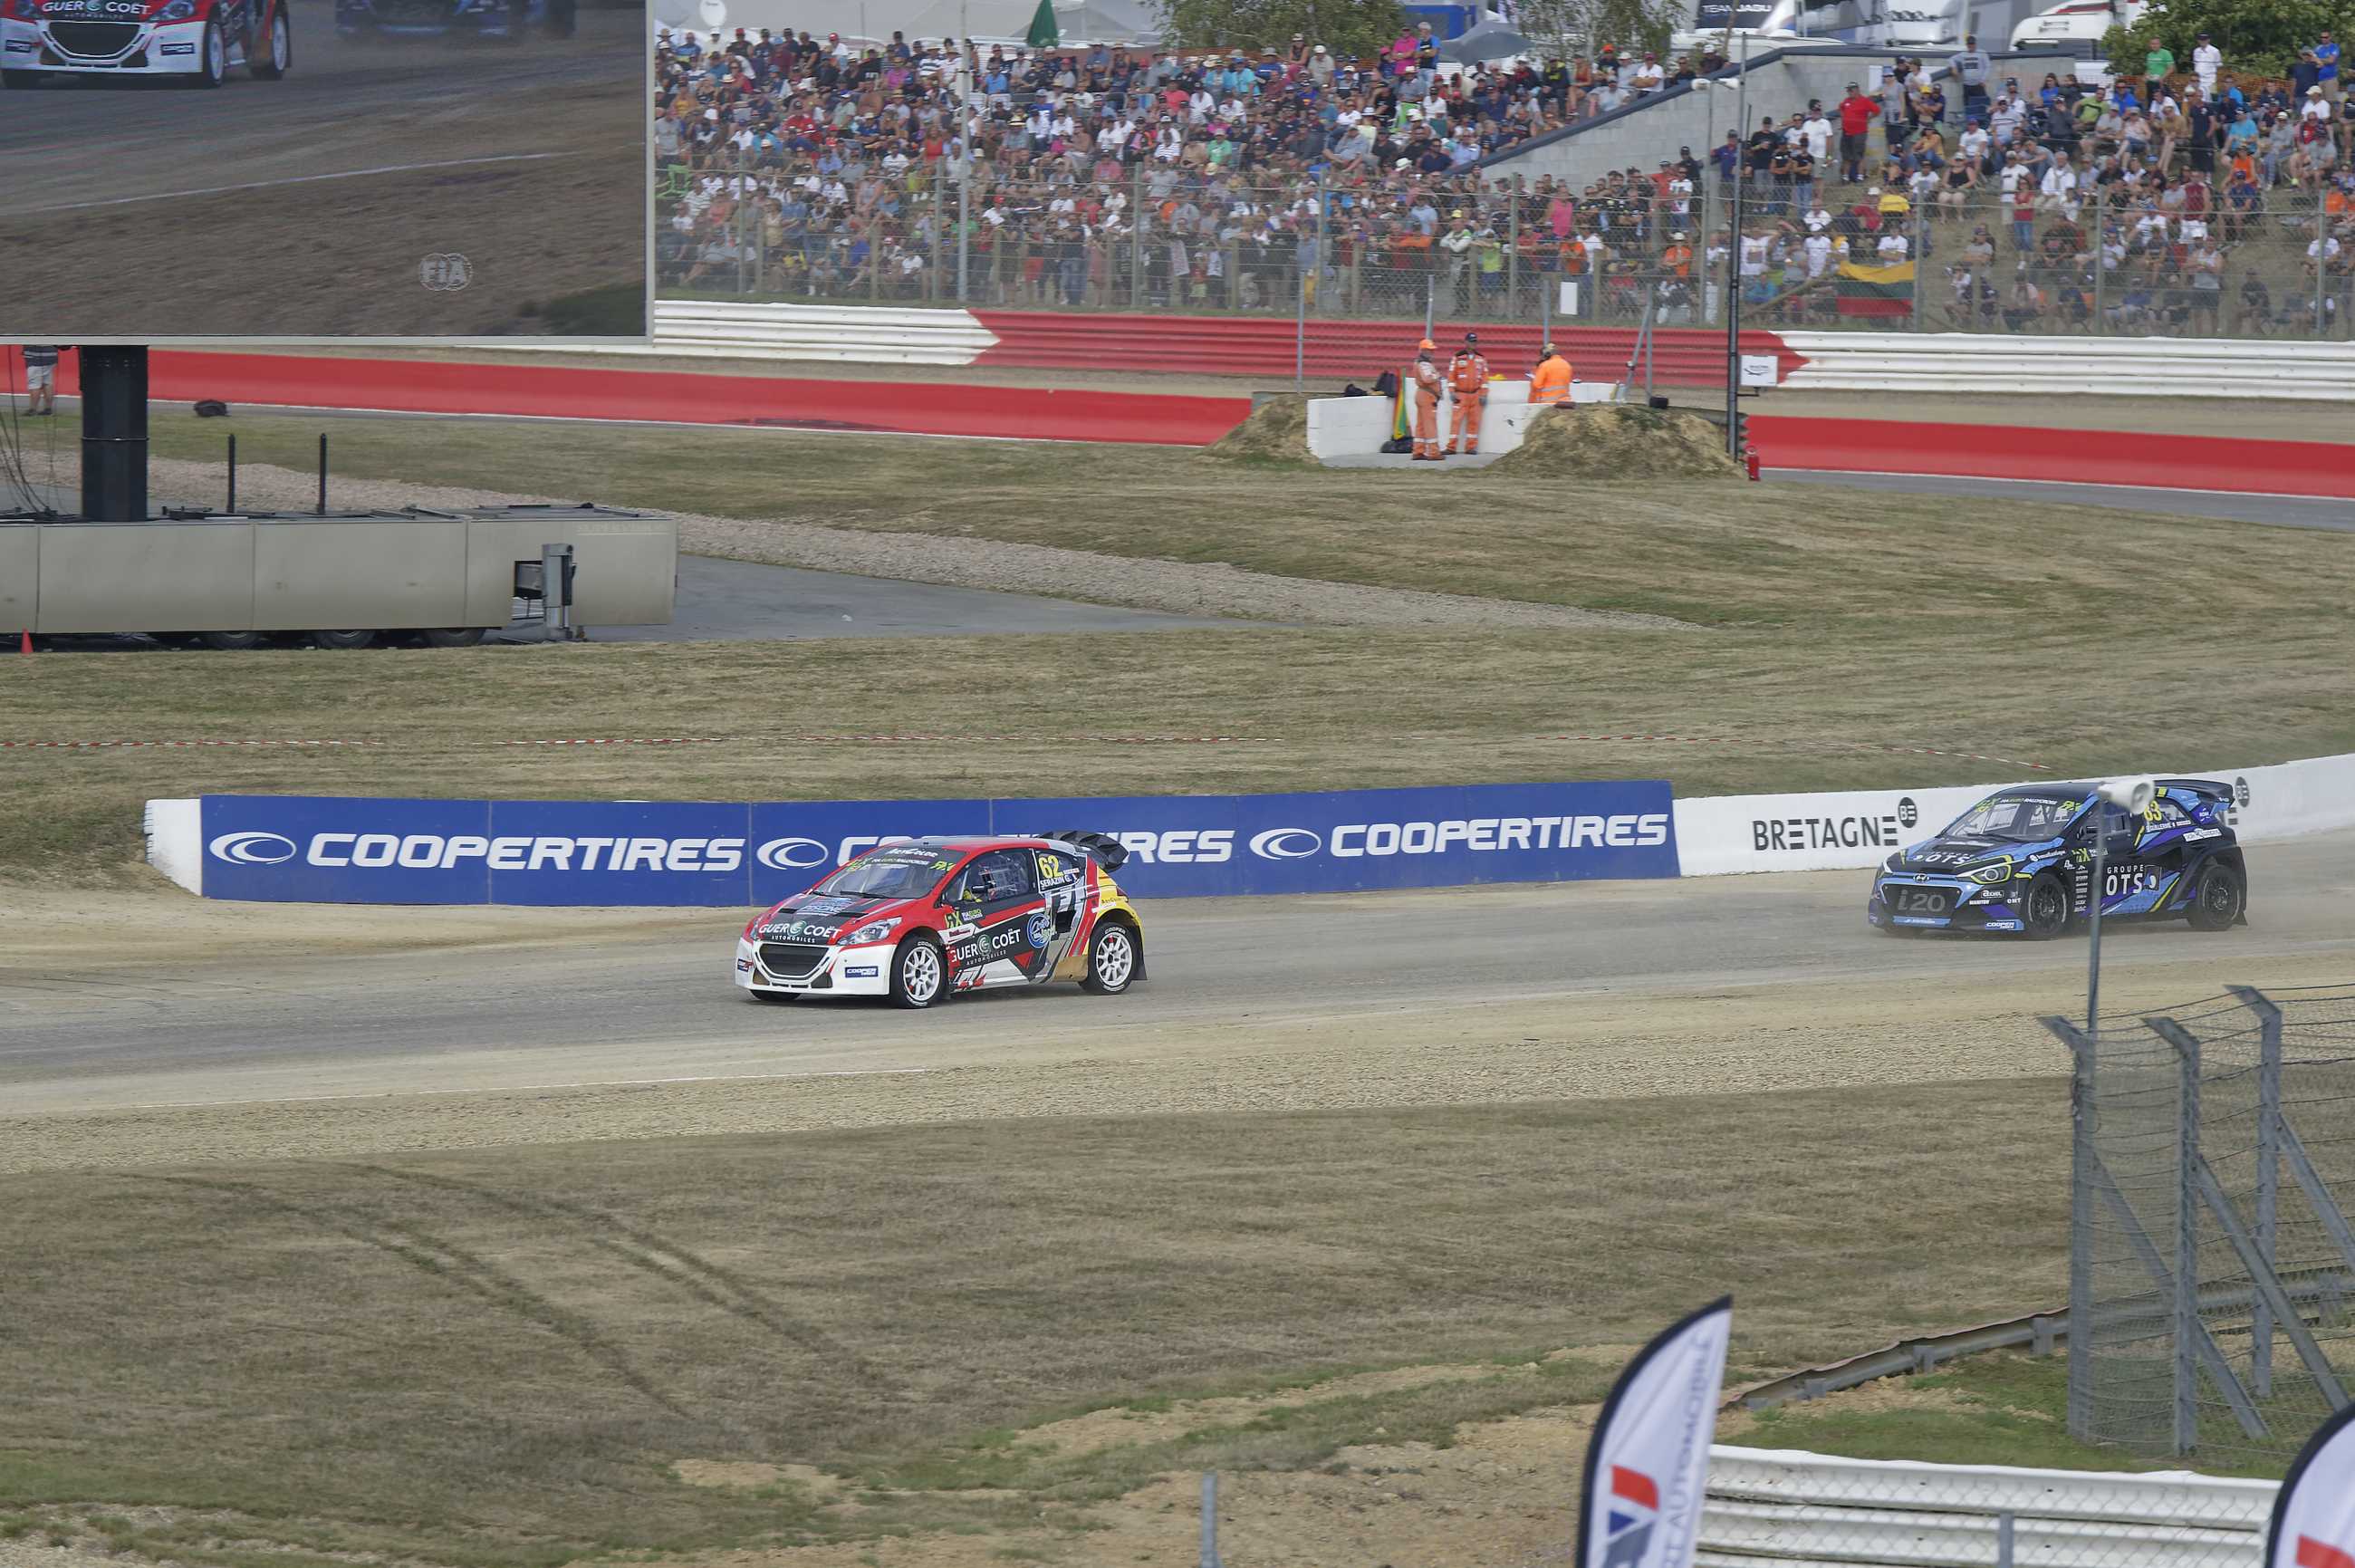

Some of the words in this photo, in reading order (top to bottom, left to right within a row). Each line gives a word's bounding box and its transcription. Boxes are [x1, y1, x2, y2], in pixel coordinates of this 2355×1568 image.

[42, 1, 83, 12] GUER
[1752, 815, 1898, 851] BRETAGNE
[1038, 854, 1064, 879] 62
[2107, 864, 2144, 874] GROUPE
[2106, 872, 2143, 896] OTS
[1898, 889, 1946, 912] i20
[759, 922, 789, 934] GUER
[803, 926, 842, 939] COËT
[992, 928, 1021, 949] COËT
